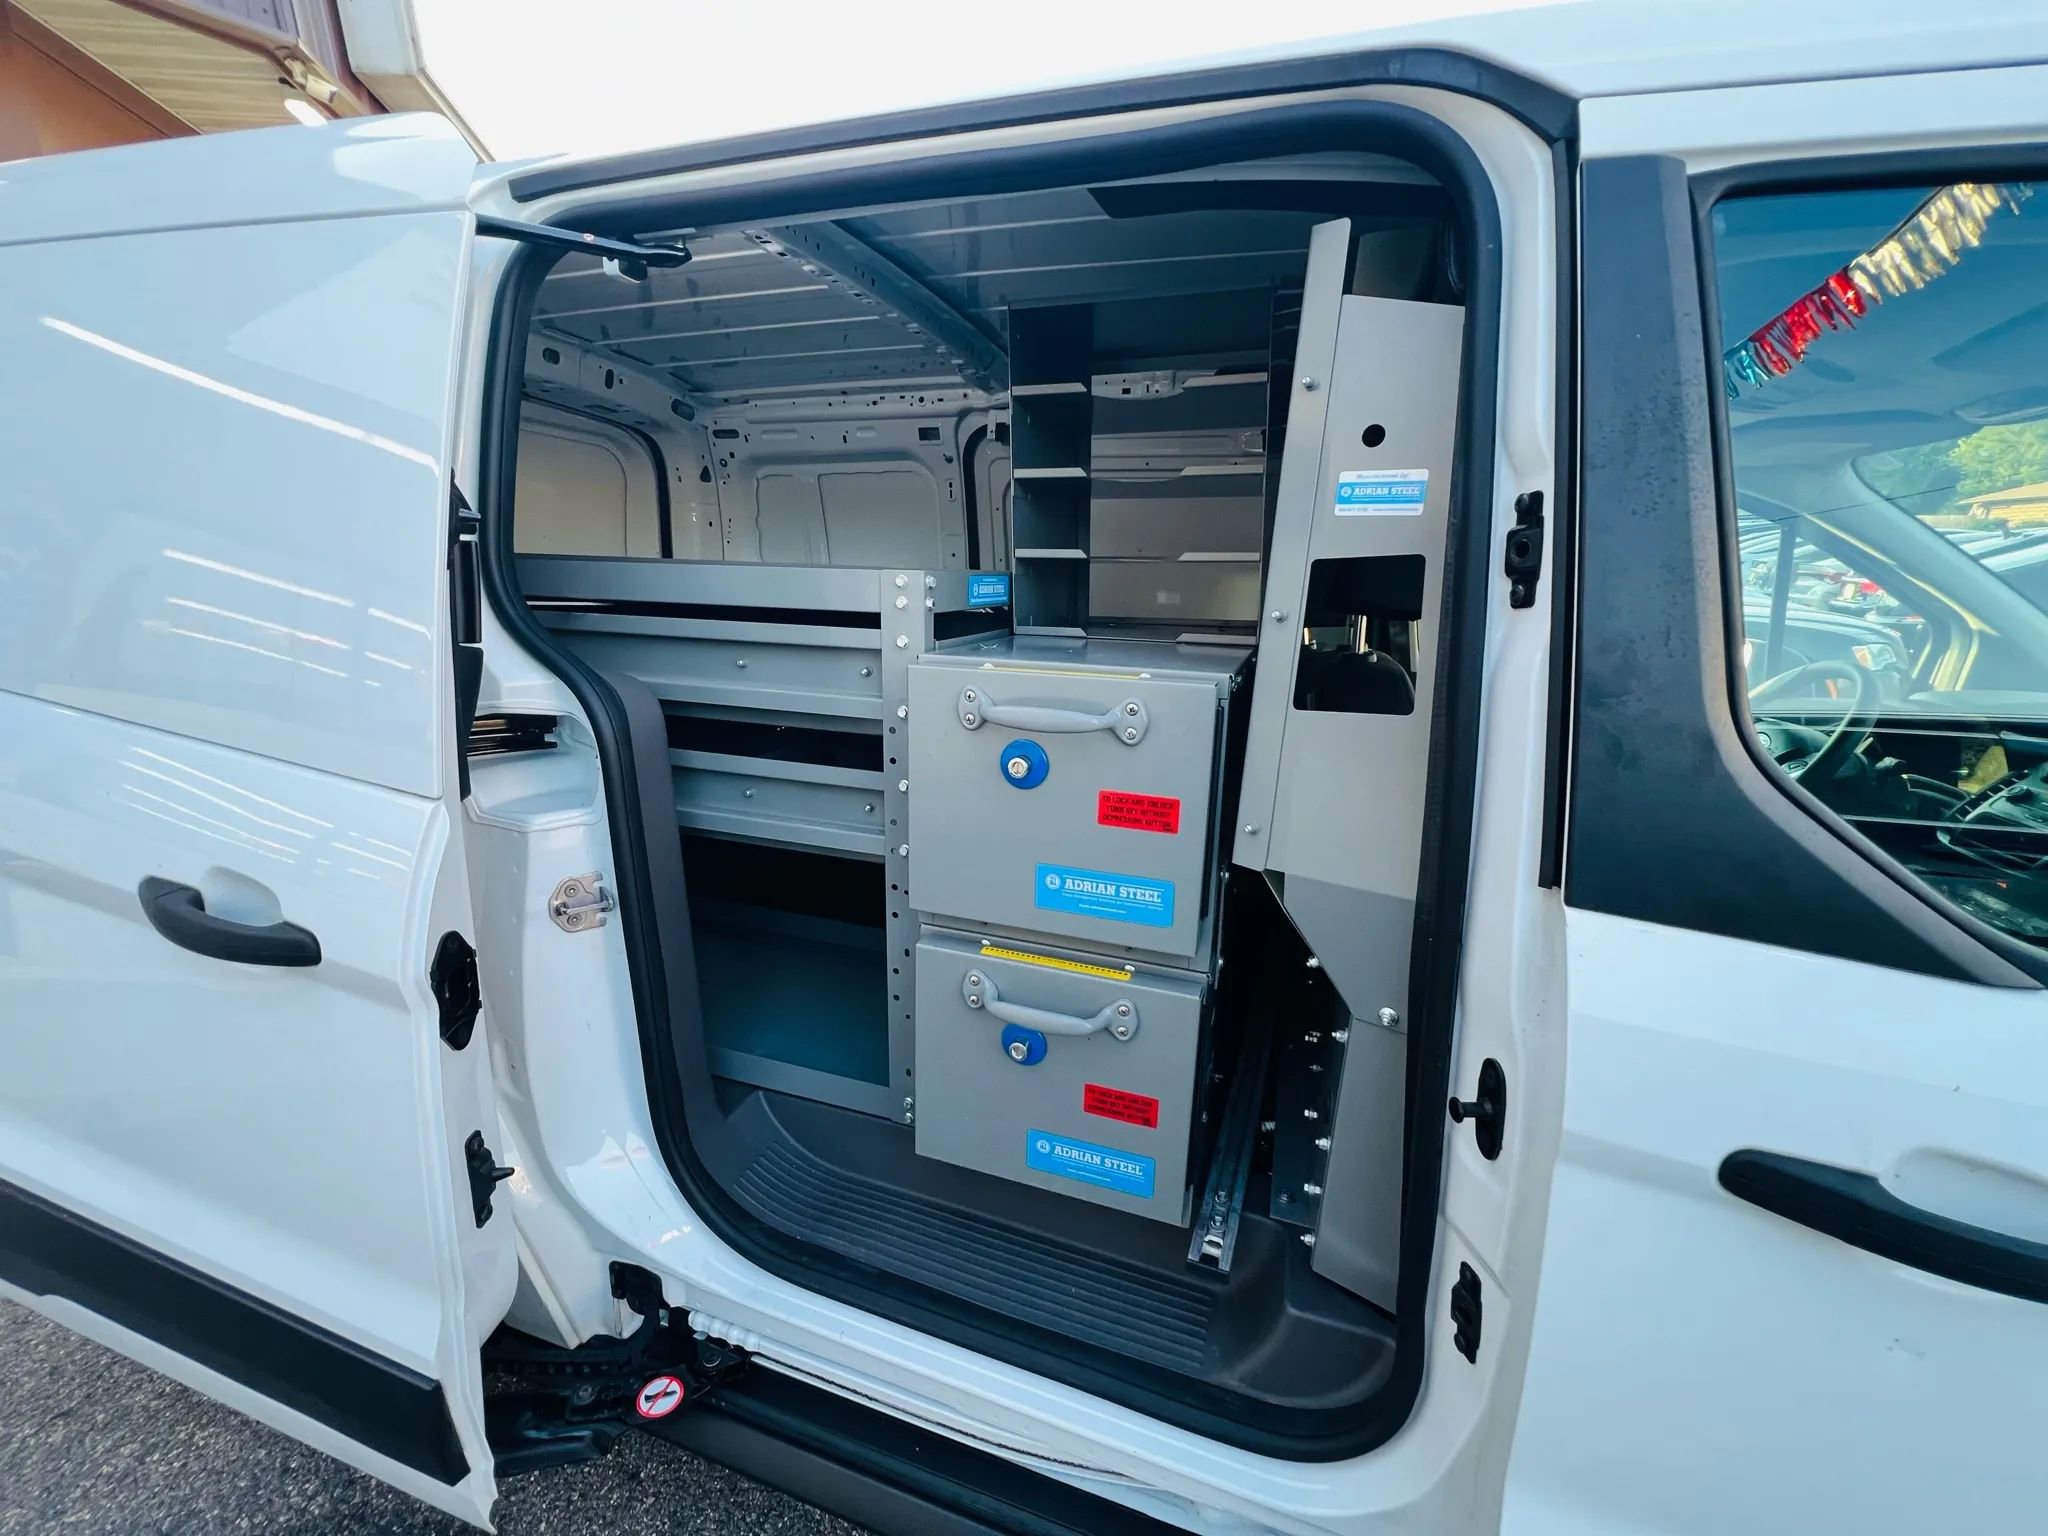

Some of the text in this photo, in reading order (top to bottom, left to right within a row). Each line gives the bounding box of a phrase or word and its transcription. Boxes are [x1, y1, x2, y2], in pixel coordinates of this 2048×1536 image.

[1353, 486, 1420, 496] ADRIAN STEEL
[1064, 879, 1116, 895] ADRIAN
[1119, 886, 1161, 902] STEEL
[1054, 1146, 1100, 1164] ADRIAN
[1104, 1158, 1143, 1175] STEEL
